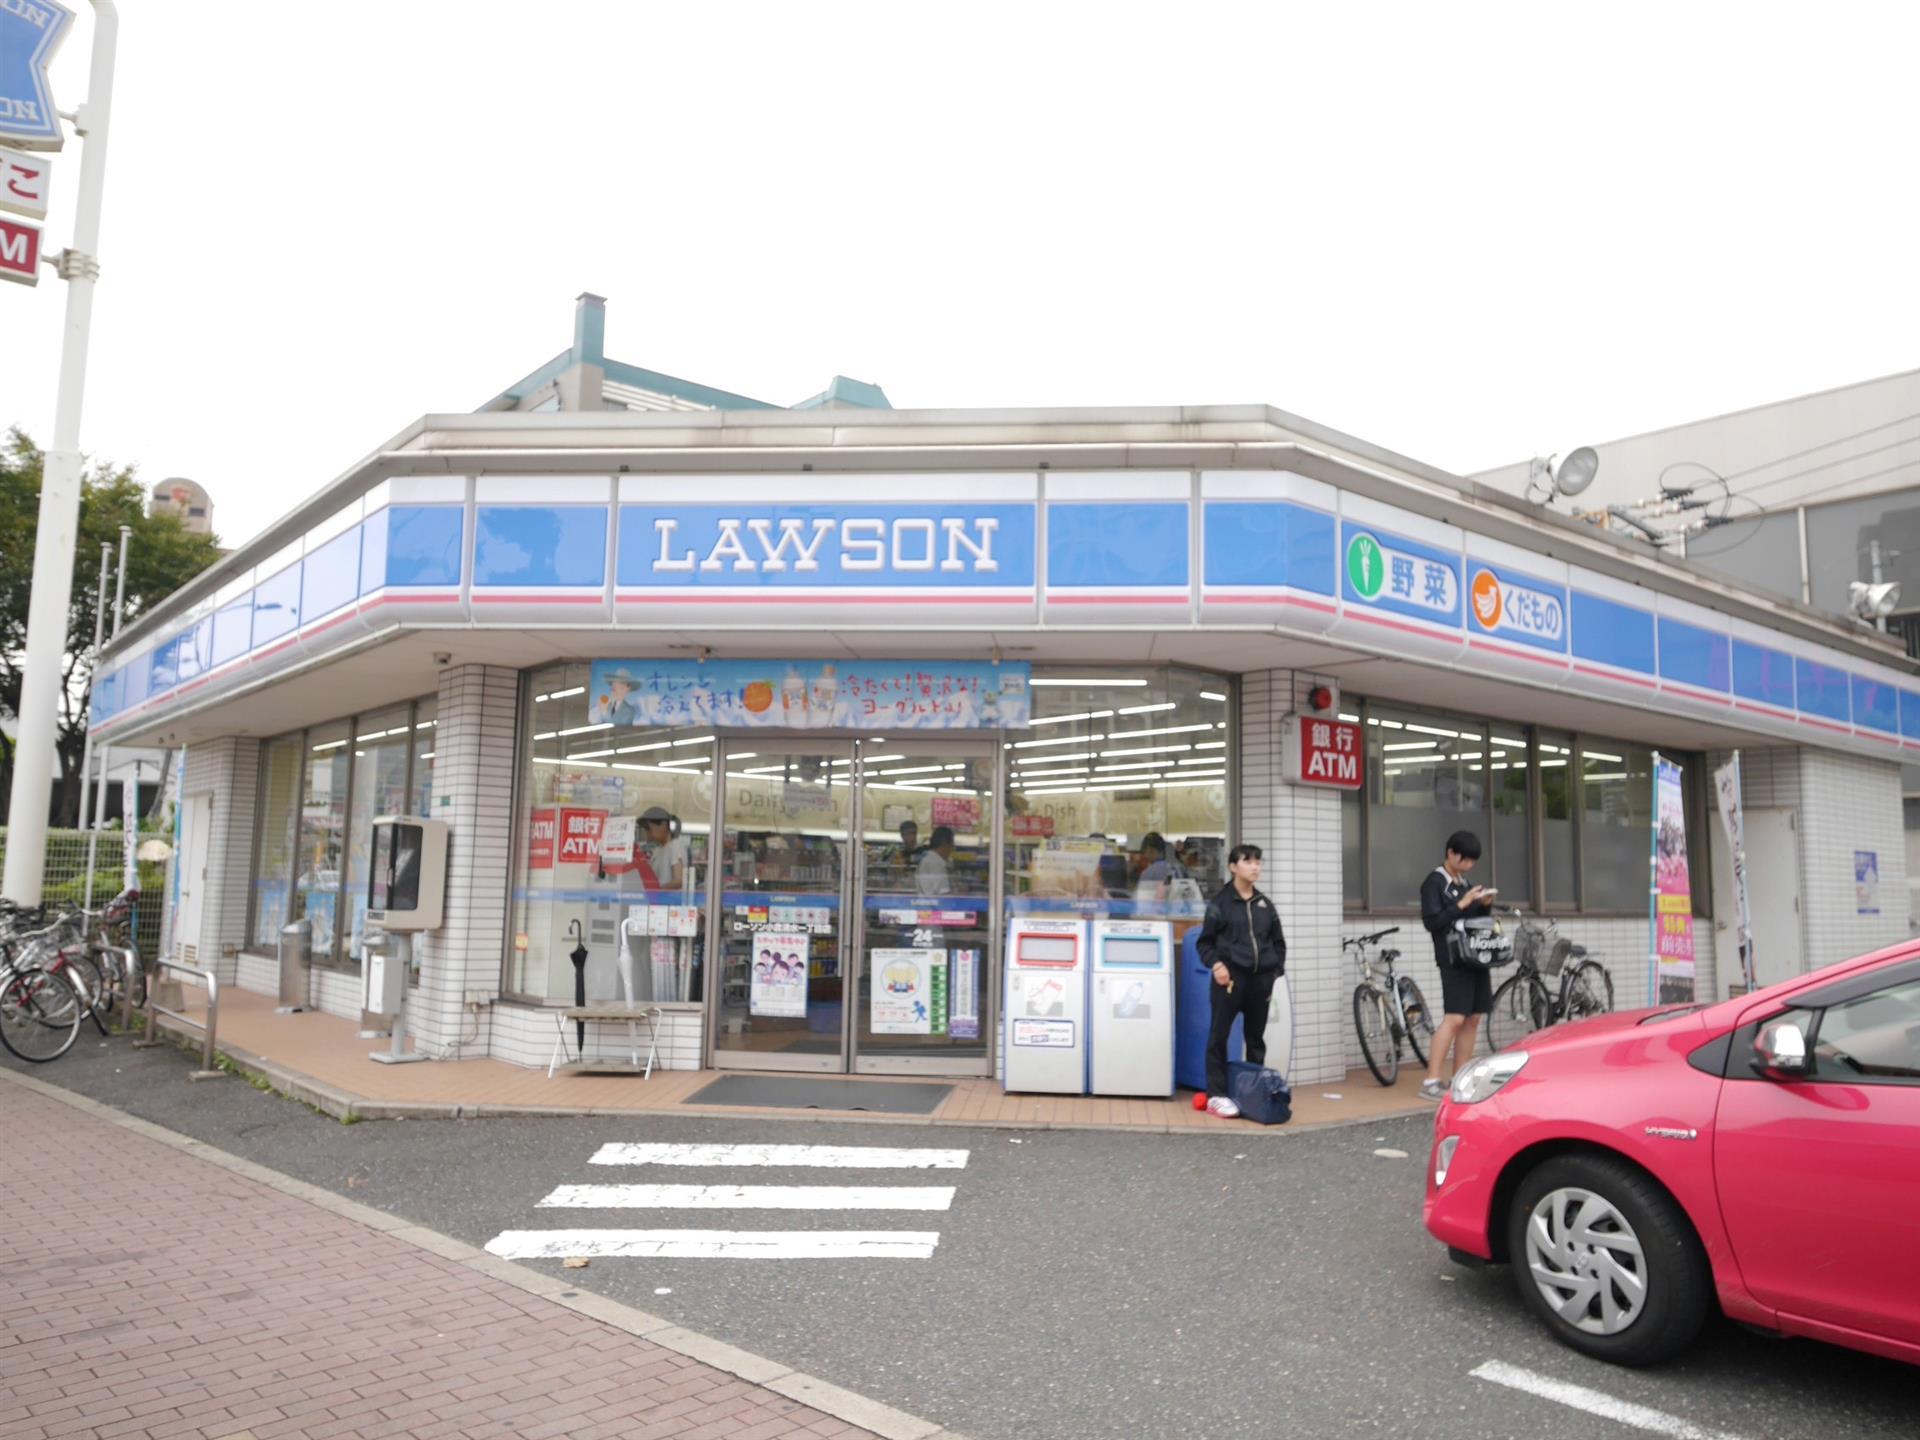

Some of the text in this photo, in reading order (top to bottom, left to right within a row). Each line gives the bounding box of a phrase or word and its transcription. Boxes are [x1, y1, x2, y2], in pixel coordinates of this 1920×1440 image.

[0, 157, 39, 200] こ
[652, 517, 1000, 572] LAWSON
[1390, 554, 1448, 607] 野菜
[1503, 588, 1559, 635] くだもの
[1311, 722, 1354, 752] 銀行
[1307, 750, 1357, 780] ATM
[567, 816, 600, 834] 銀行
[562, 837, 601, 855] ATM
[912, 928, 934, 942] 24
